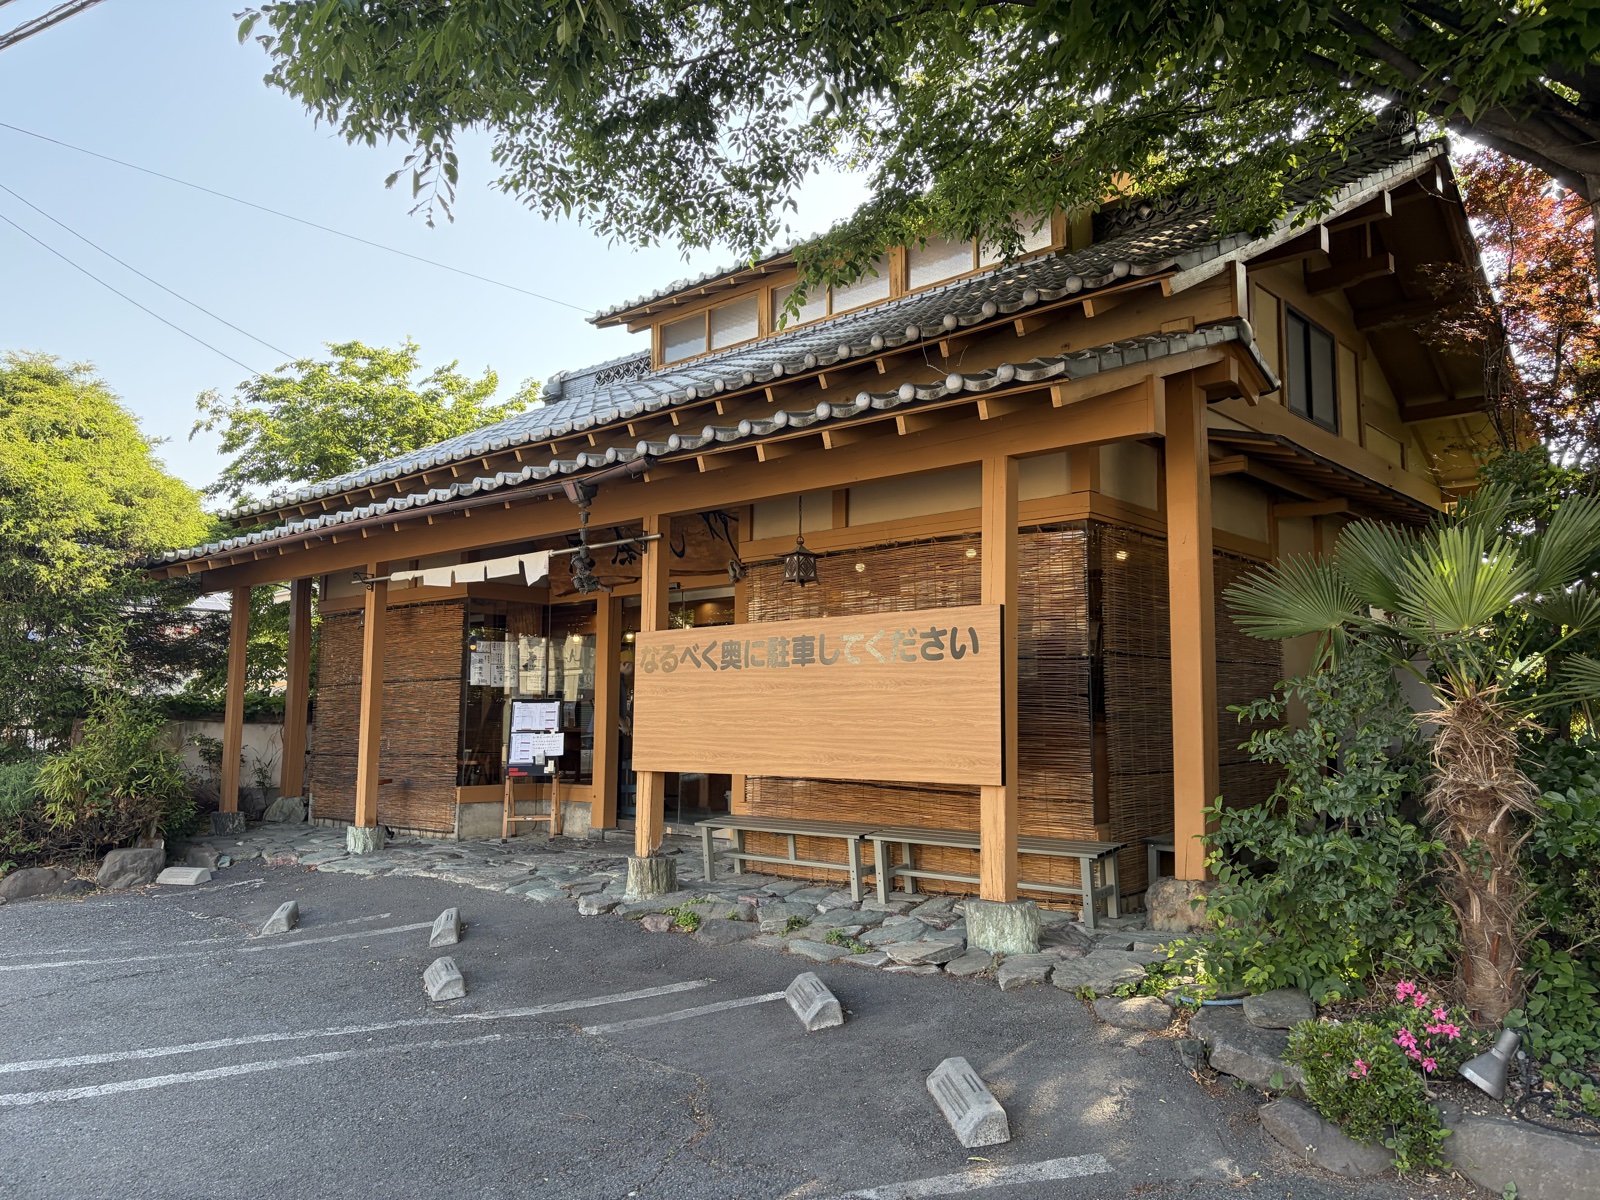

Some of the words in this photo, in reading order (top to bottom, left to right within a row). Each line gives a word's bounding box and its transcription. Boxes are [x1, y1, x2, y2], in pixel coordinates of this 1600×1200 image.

[640, 626, 979, 673] なるべく奥に駐車してください
